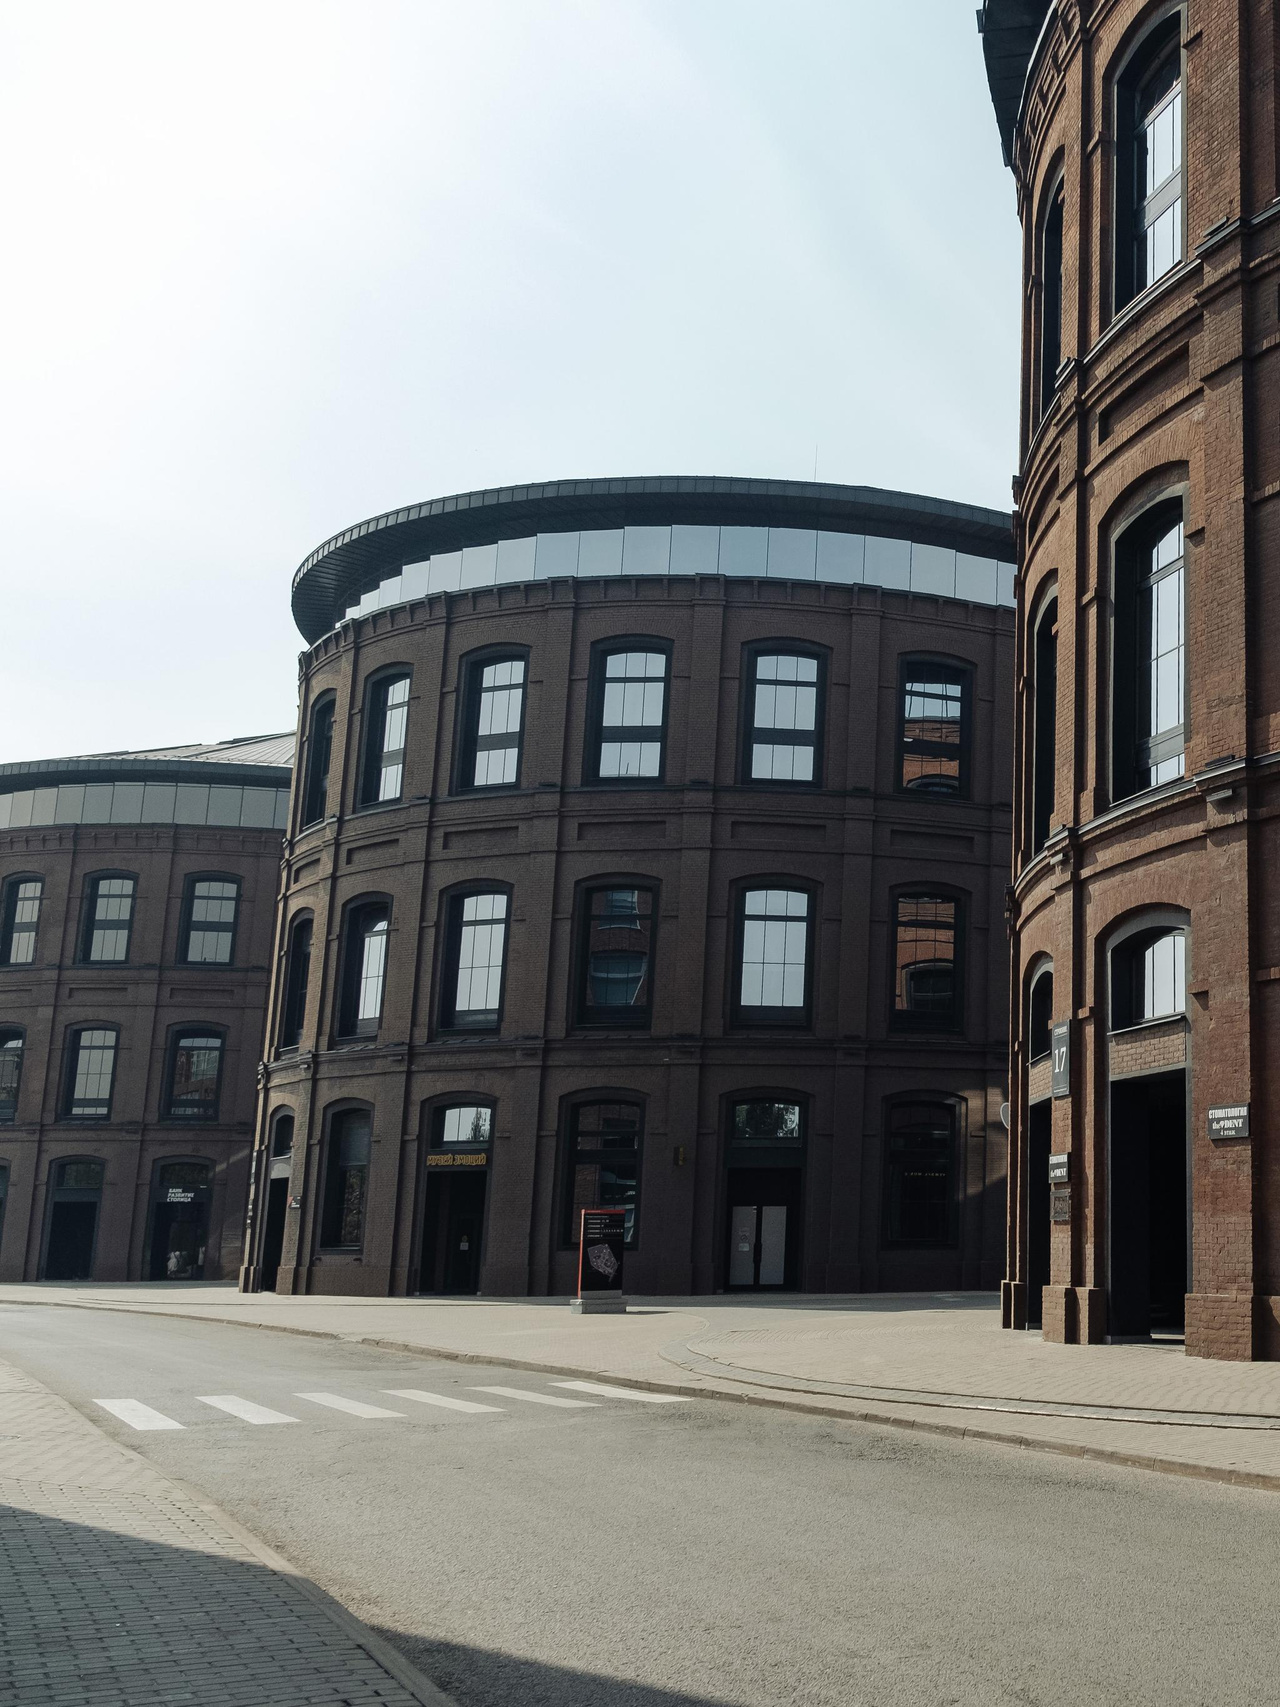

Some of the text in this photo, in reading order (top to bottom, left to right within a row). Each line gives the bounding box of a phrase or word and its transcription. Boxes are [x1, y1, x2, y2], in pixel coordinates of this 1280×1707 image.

[1054, 1046, 1067, 1073] 17
[1209, 1107, 1247, 1119] СТОМАТОЛОГИЯ
[427, 1153, 486, 1166] МУЗЕЙ ЭМОЦИЙ
